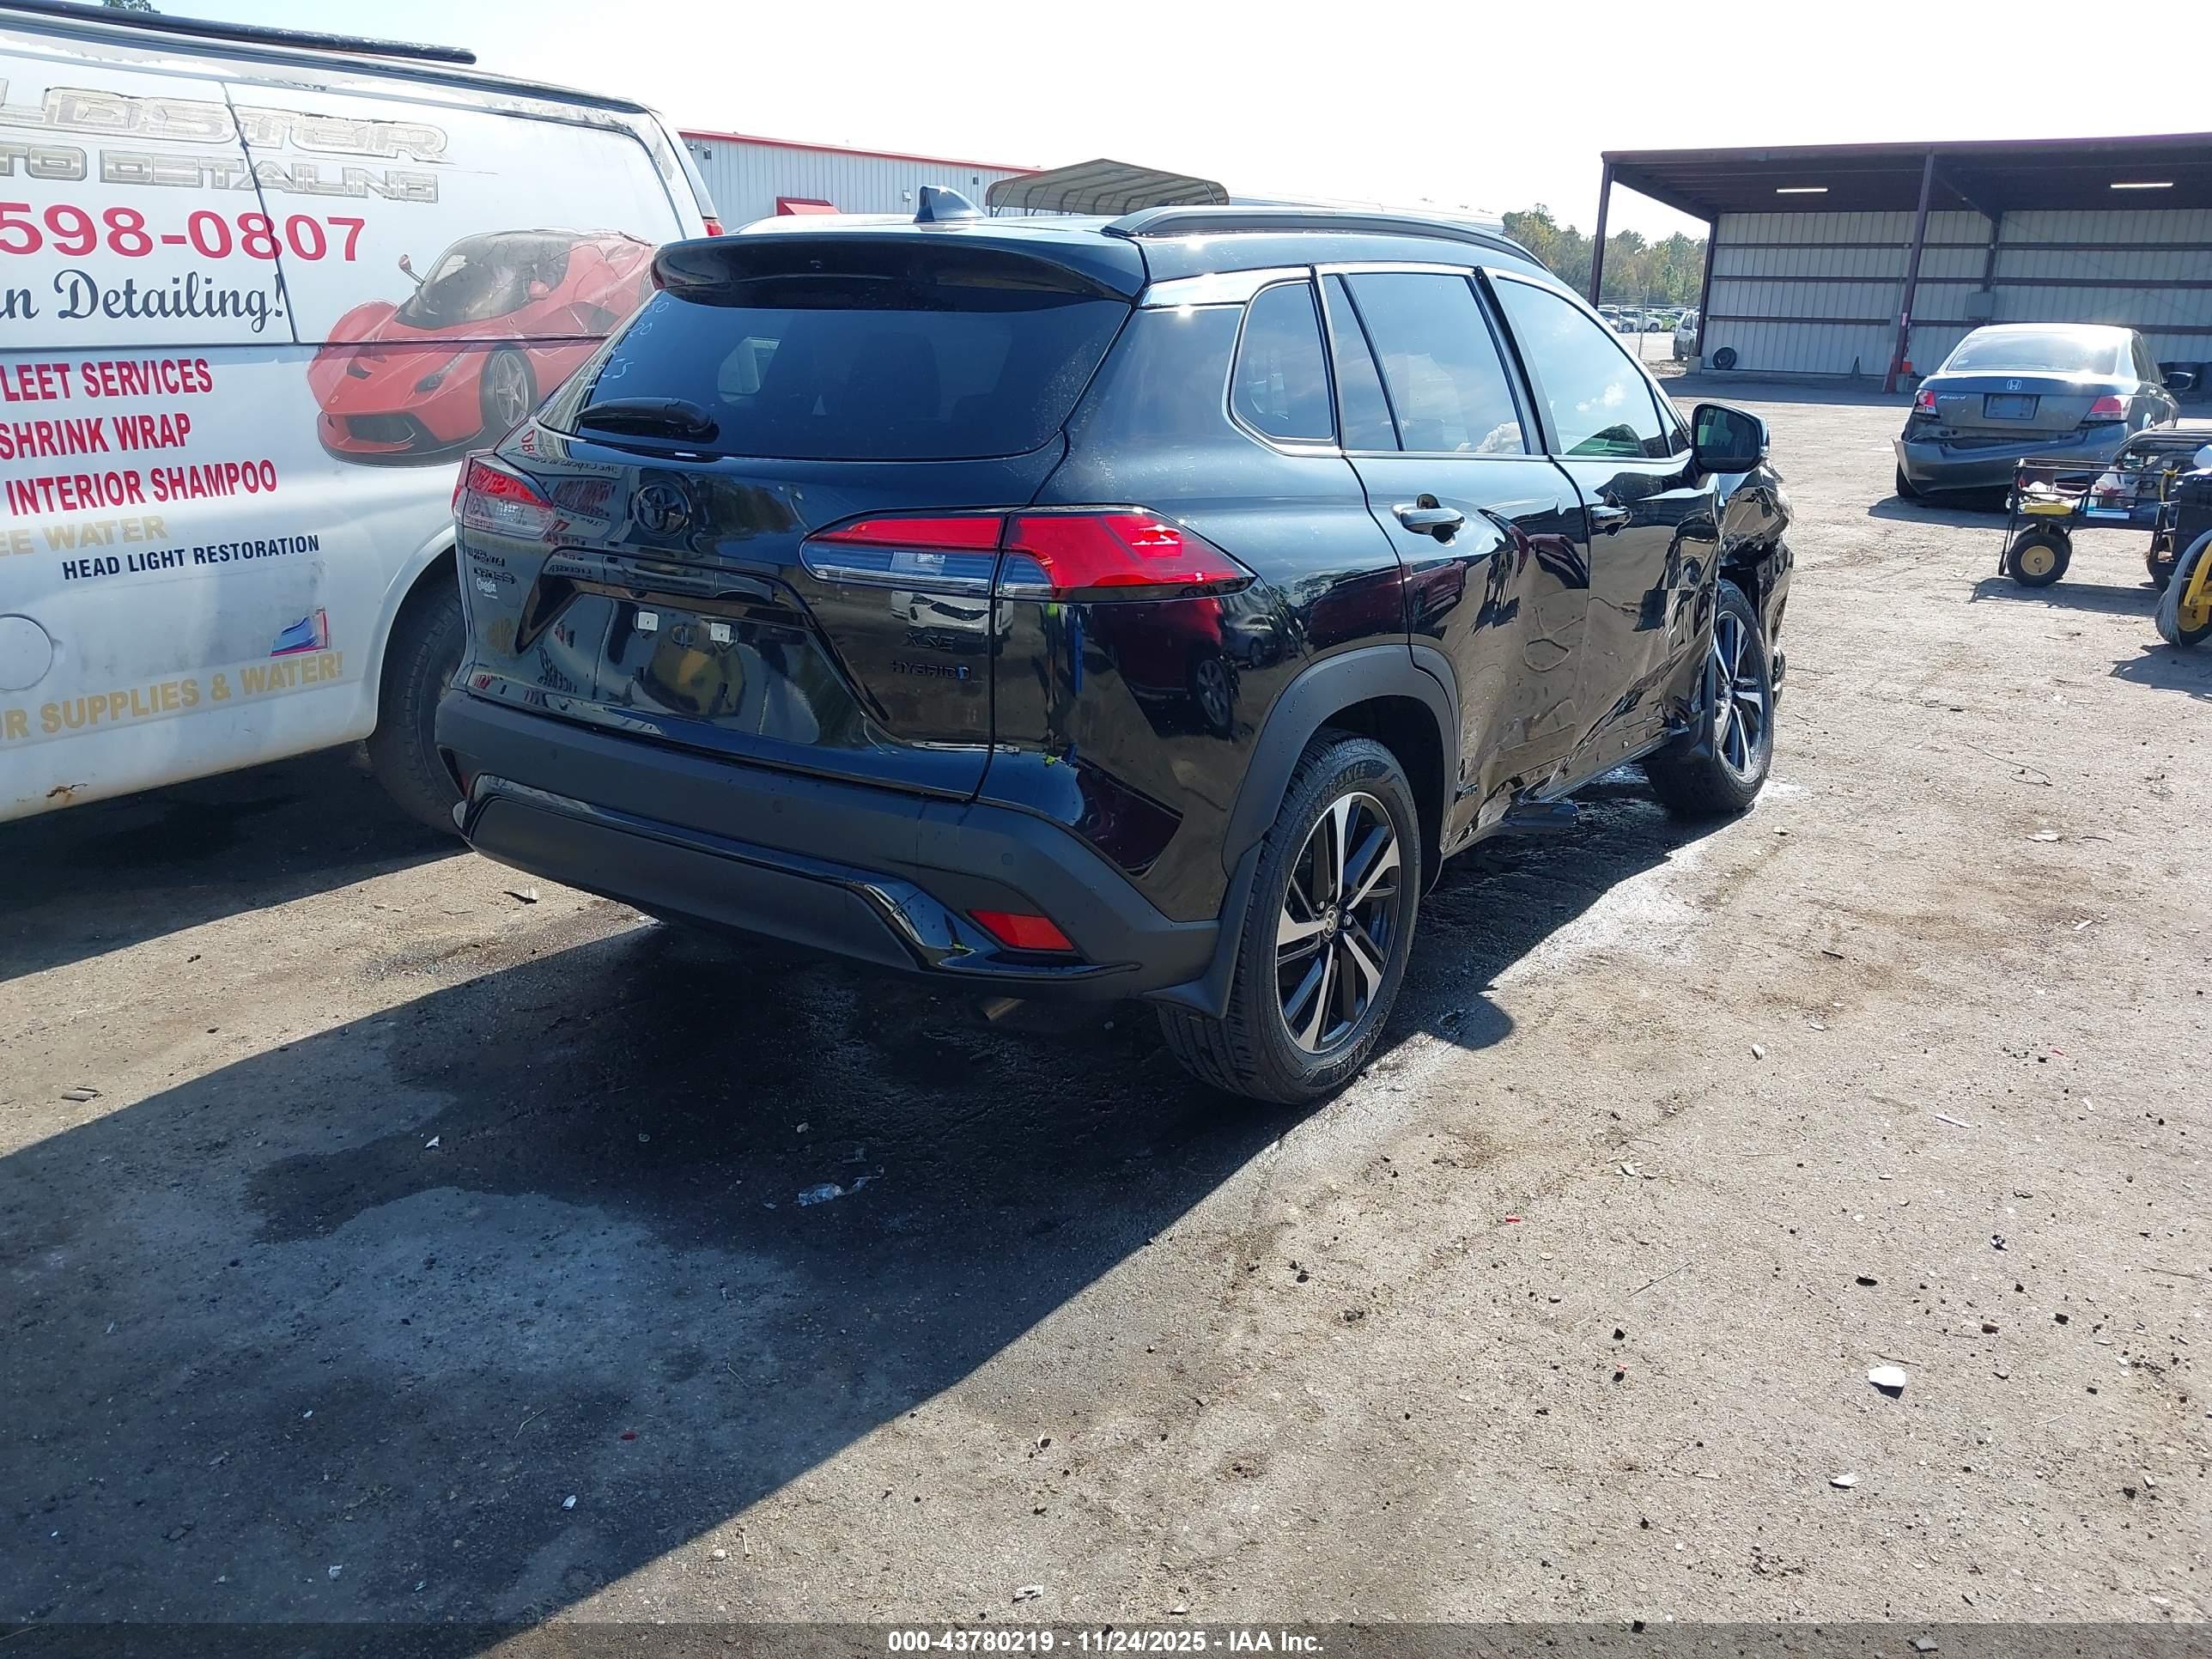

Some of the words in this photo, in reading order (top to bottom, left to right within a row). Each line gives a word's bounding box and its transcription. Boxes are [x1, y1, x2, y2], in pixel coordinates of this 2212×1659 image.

[0, 202, 365, 262] 598-0807
[53, 269, 284, 333] Detailing!
[81, 358, 213, 398] SERVICES
[0, 417, 110, 459] SHRINK
[112, 413, 191, 452] WRAP
[6, 470, 145, 515] INTERIOR
[153, 459, 277, 501] SHAMPOO
[43, 515, 167, 550] WATER
[62, 556, 120, 580] HEAD
[127, 549, 185, 573] LIGHT
[193, 535, 319, 567] RESTORATION
[0, 708, 29, 741] R
[40, 679, 200, 733] SUPPLIES
[210, 672, 232, 702] &
[240, 653, 343, 696] WATER!
